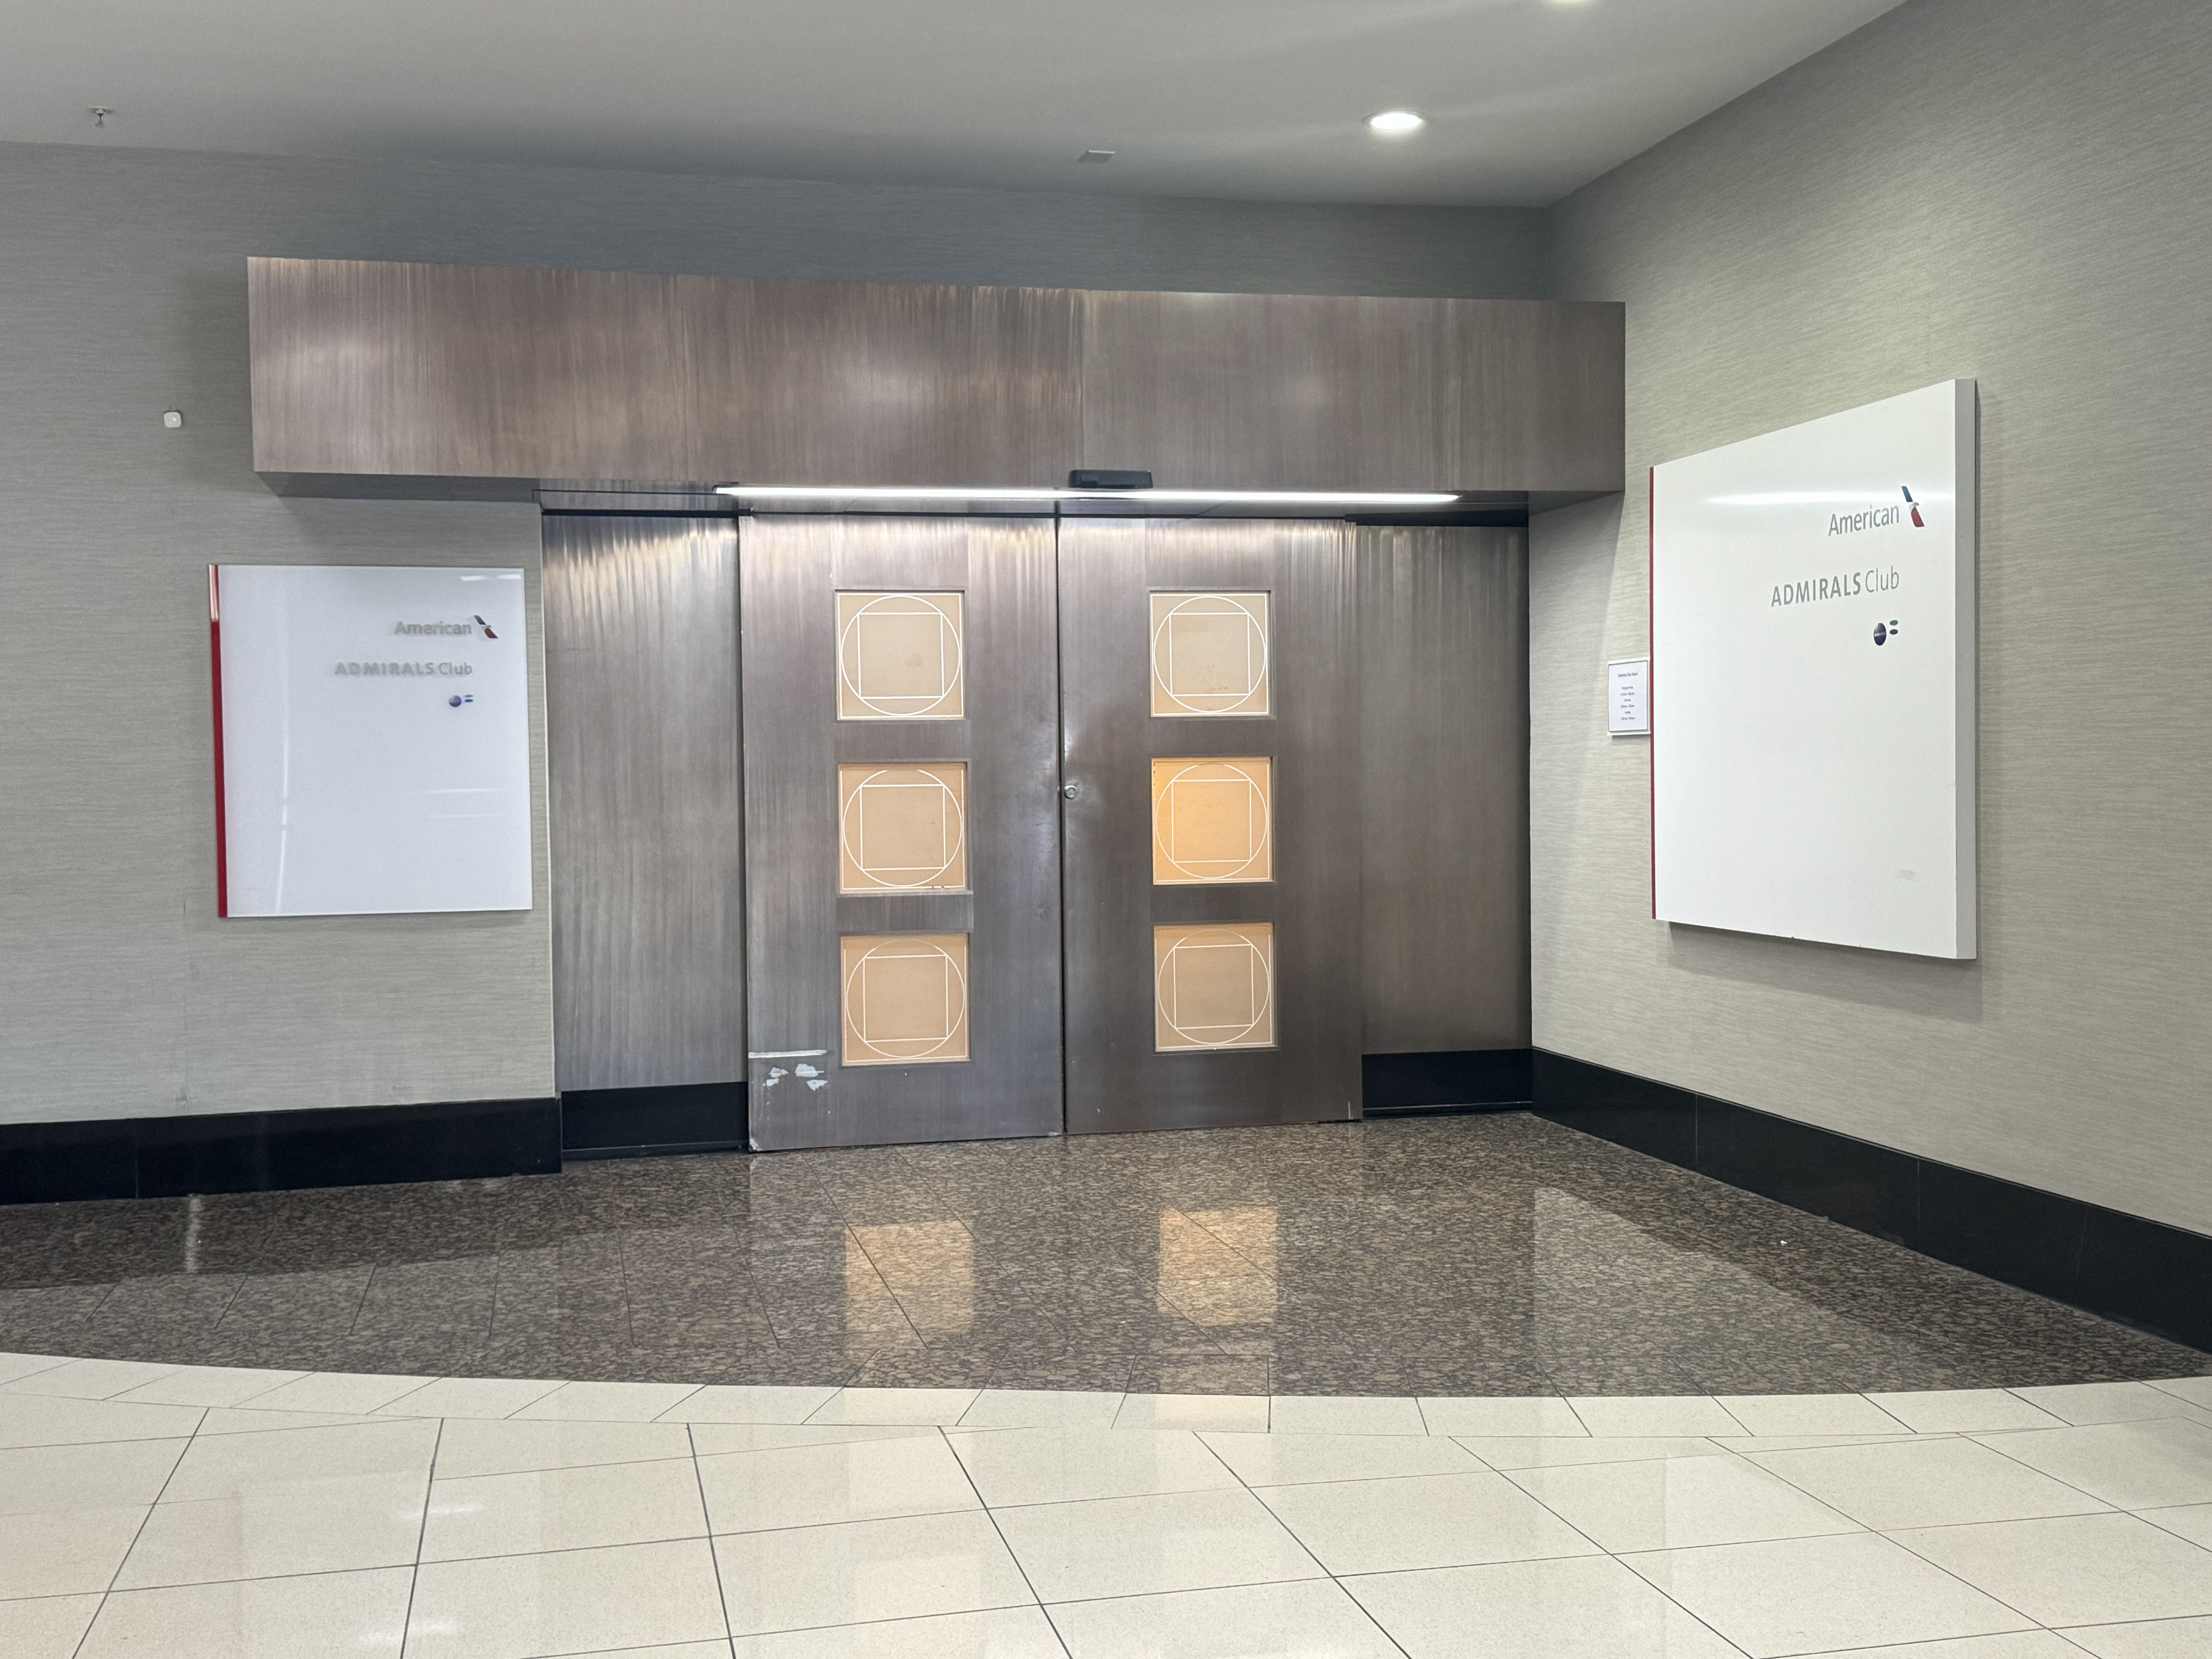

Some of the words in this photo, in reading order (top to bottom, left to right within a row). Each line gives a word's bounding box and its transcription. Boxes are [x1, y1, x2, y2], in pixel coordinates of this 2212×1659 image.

[1829, 505, 1899, 537] American
[1771, 572, 1860, 607] ADMIRALS
[1865, 565, 1899, 593] Club
[394, 621, 471, 635] American
[334, 662, 434, 675] ADMIRALS
[438, 662, 472, 675] Club
